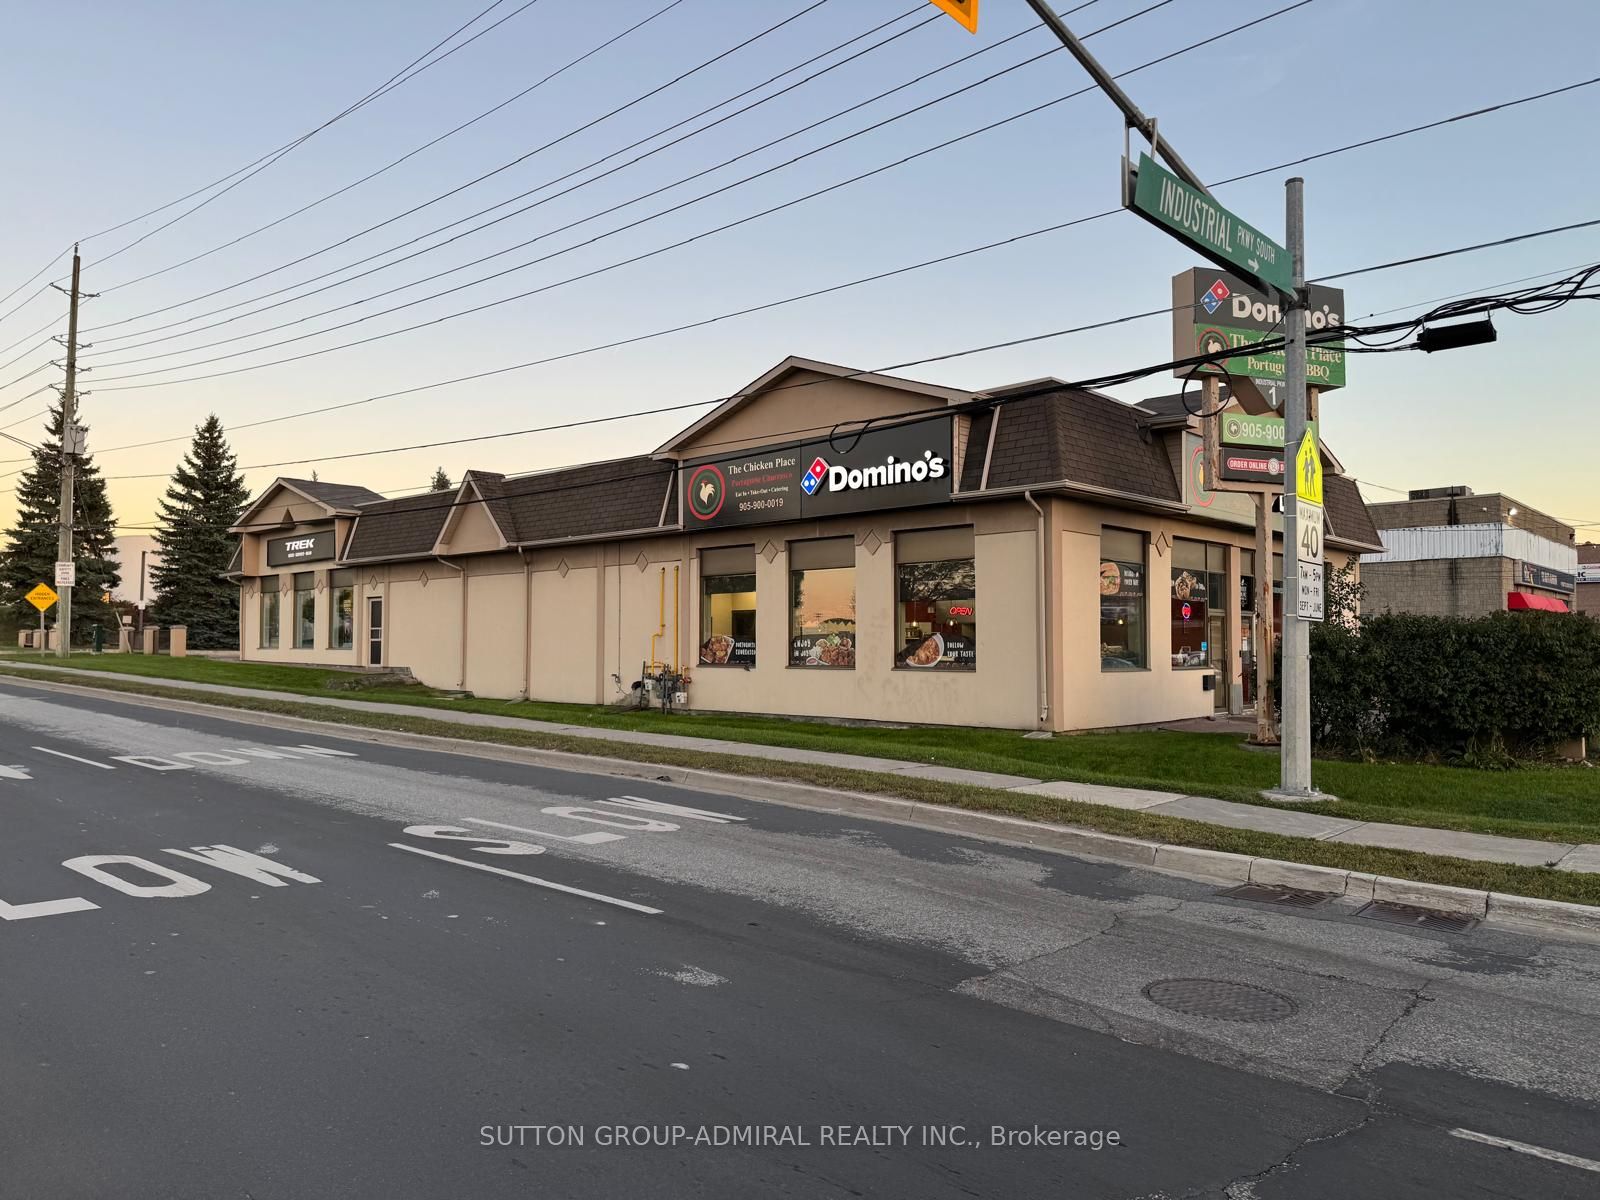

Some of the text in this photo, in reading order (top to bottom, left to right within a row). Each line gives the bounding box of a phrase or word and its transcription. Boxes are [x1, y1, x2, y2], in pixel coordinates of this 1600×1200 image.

[1159, 177, 1275, 265] INDUSTRIAL PKWY SOUTH
[1232, 293, 1340, 329] Domo's
[1306, 364, 1330, 381] BBQ
[1268, 386, 1277, 406] 1
[1241, 422, 1285, 440] 905-900
[728, 457, 796, 475] The Chicken Place
[828, 449, 945, 492] Domino's
[1229, 459, 1248, 469] ORDER
[1248, 461, 1268, 470] ONLINE
[750, 488, 768, 496] Take-Out
[739, 497, 784, 512] 905-900-0019
[1299, 507, 1322, 525] MAXIMUM
[285, 538, 315, 551] TREK
[1302, 524, 1319, 559] 40
[1300, 565, 1321, 583] 7AM 5PM
[1302, 585, 1310, 596] MON
[949, 607, 973, 615] OPEN
[1299, 600, 1322, 613] SEPT JUNE
[960, 650, 975, 658] TASTE
[402, 795, 748, 855] SLOW
